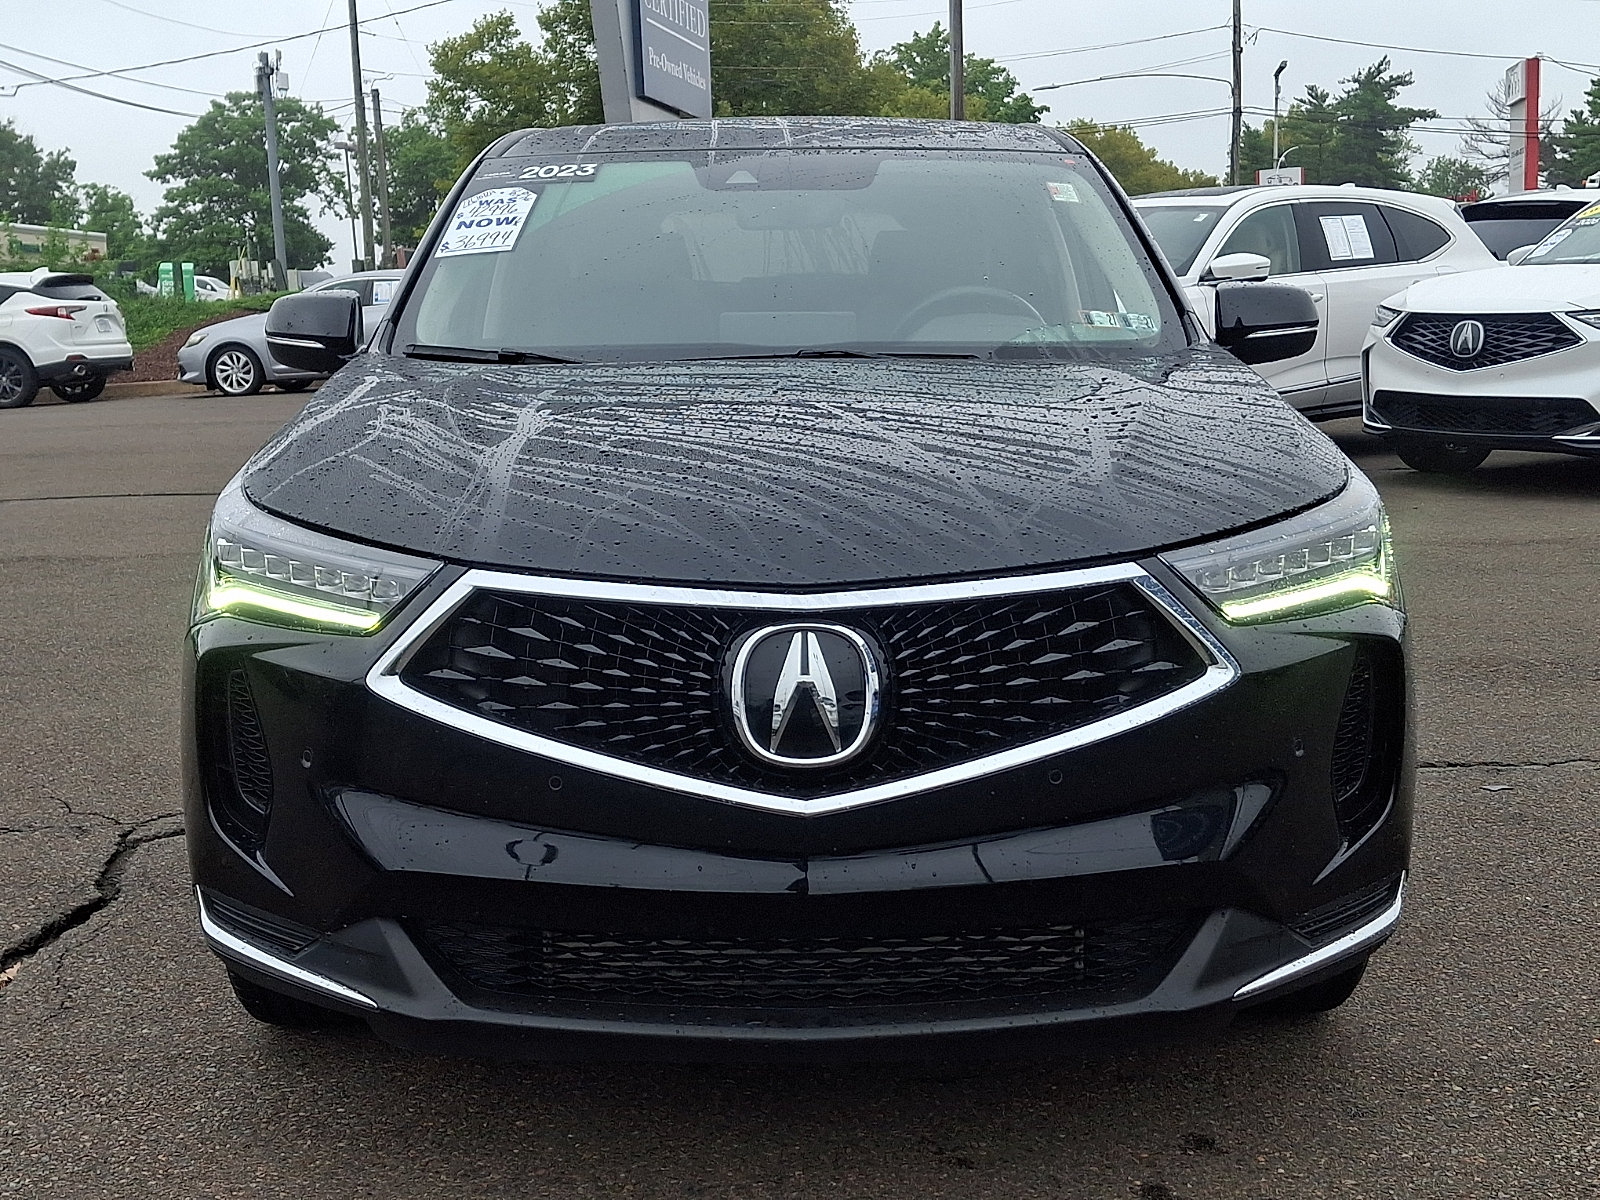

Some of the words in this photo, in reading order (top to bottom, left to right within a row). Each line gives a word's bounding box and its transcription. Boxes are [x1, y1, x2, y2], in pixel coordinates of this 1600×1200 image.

[648, 46, 683, 79] Pre-Owned
[683, 63, 706, 90] Vehicles
[518, 163, 598, 180] 2023
[478, 197, 517, 208] WAS
[455, 215, 519, 231] NOW
